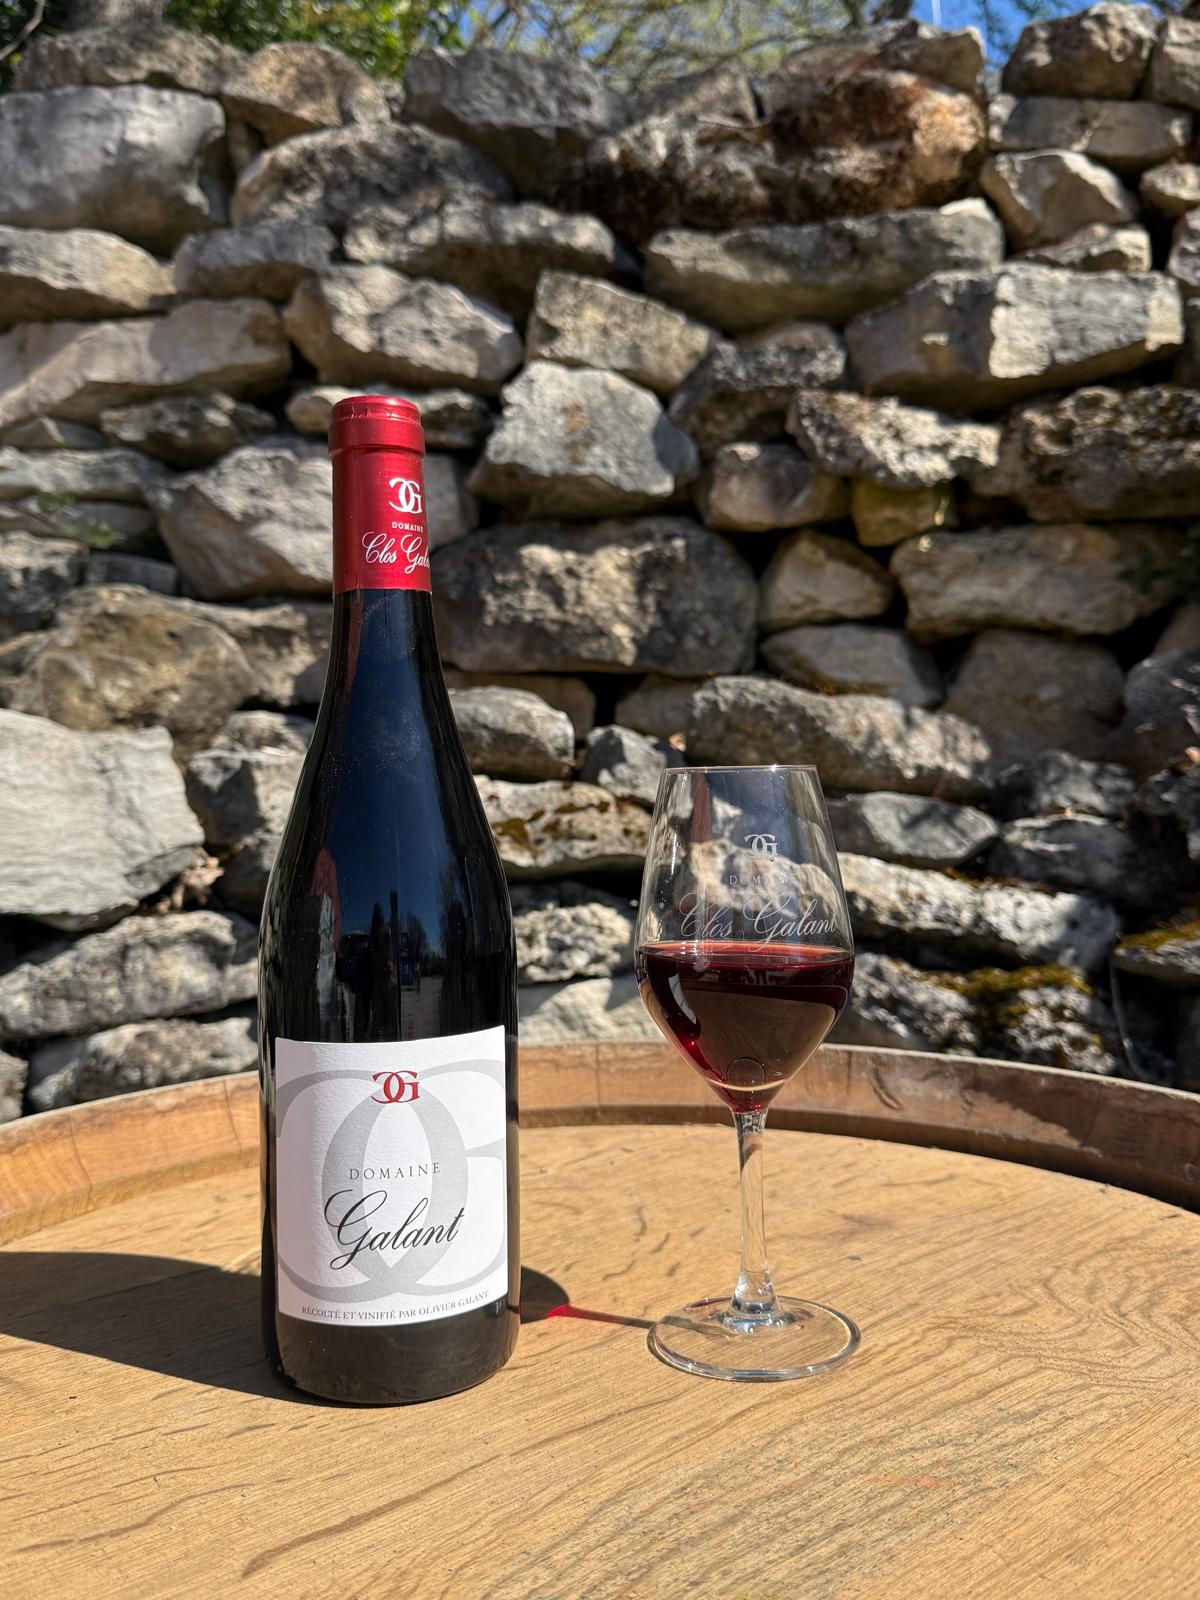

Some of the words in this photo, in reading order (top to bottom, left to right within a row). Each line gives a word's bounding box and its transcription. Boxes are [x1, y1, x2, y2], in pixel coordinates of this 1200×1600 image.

[391, 521, 424, 533] DOMAINE
[361, 531, 397, 564] Clos
[678, 893, 733, 938] Clos
[743, 893, 837, 952] Galant
[349, 1162, 441, 1180] DOMAINE
[324, 1189, 465, 1270] Galant
[302, 1305, 341, 1319] RÉCOLTÉ
[343, 1311, 356, 1319] ET
[358, 1309, 396, 1320] VINIFIÉ
[399, 1309, 416, 1318] PAR
[418, 1301, 456, 1315] OLIVIER
[458, 1289, 489, 1307] GALANT
